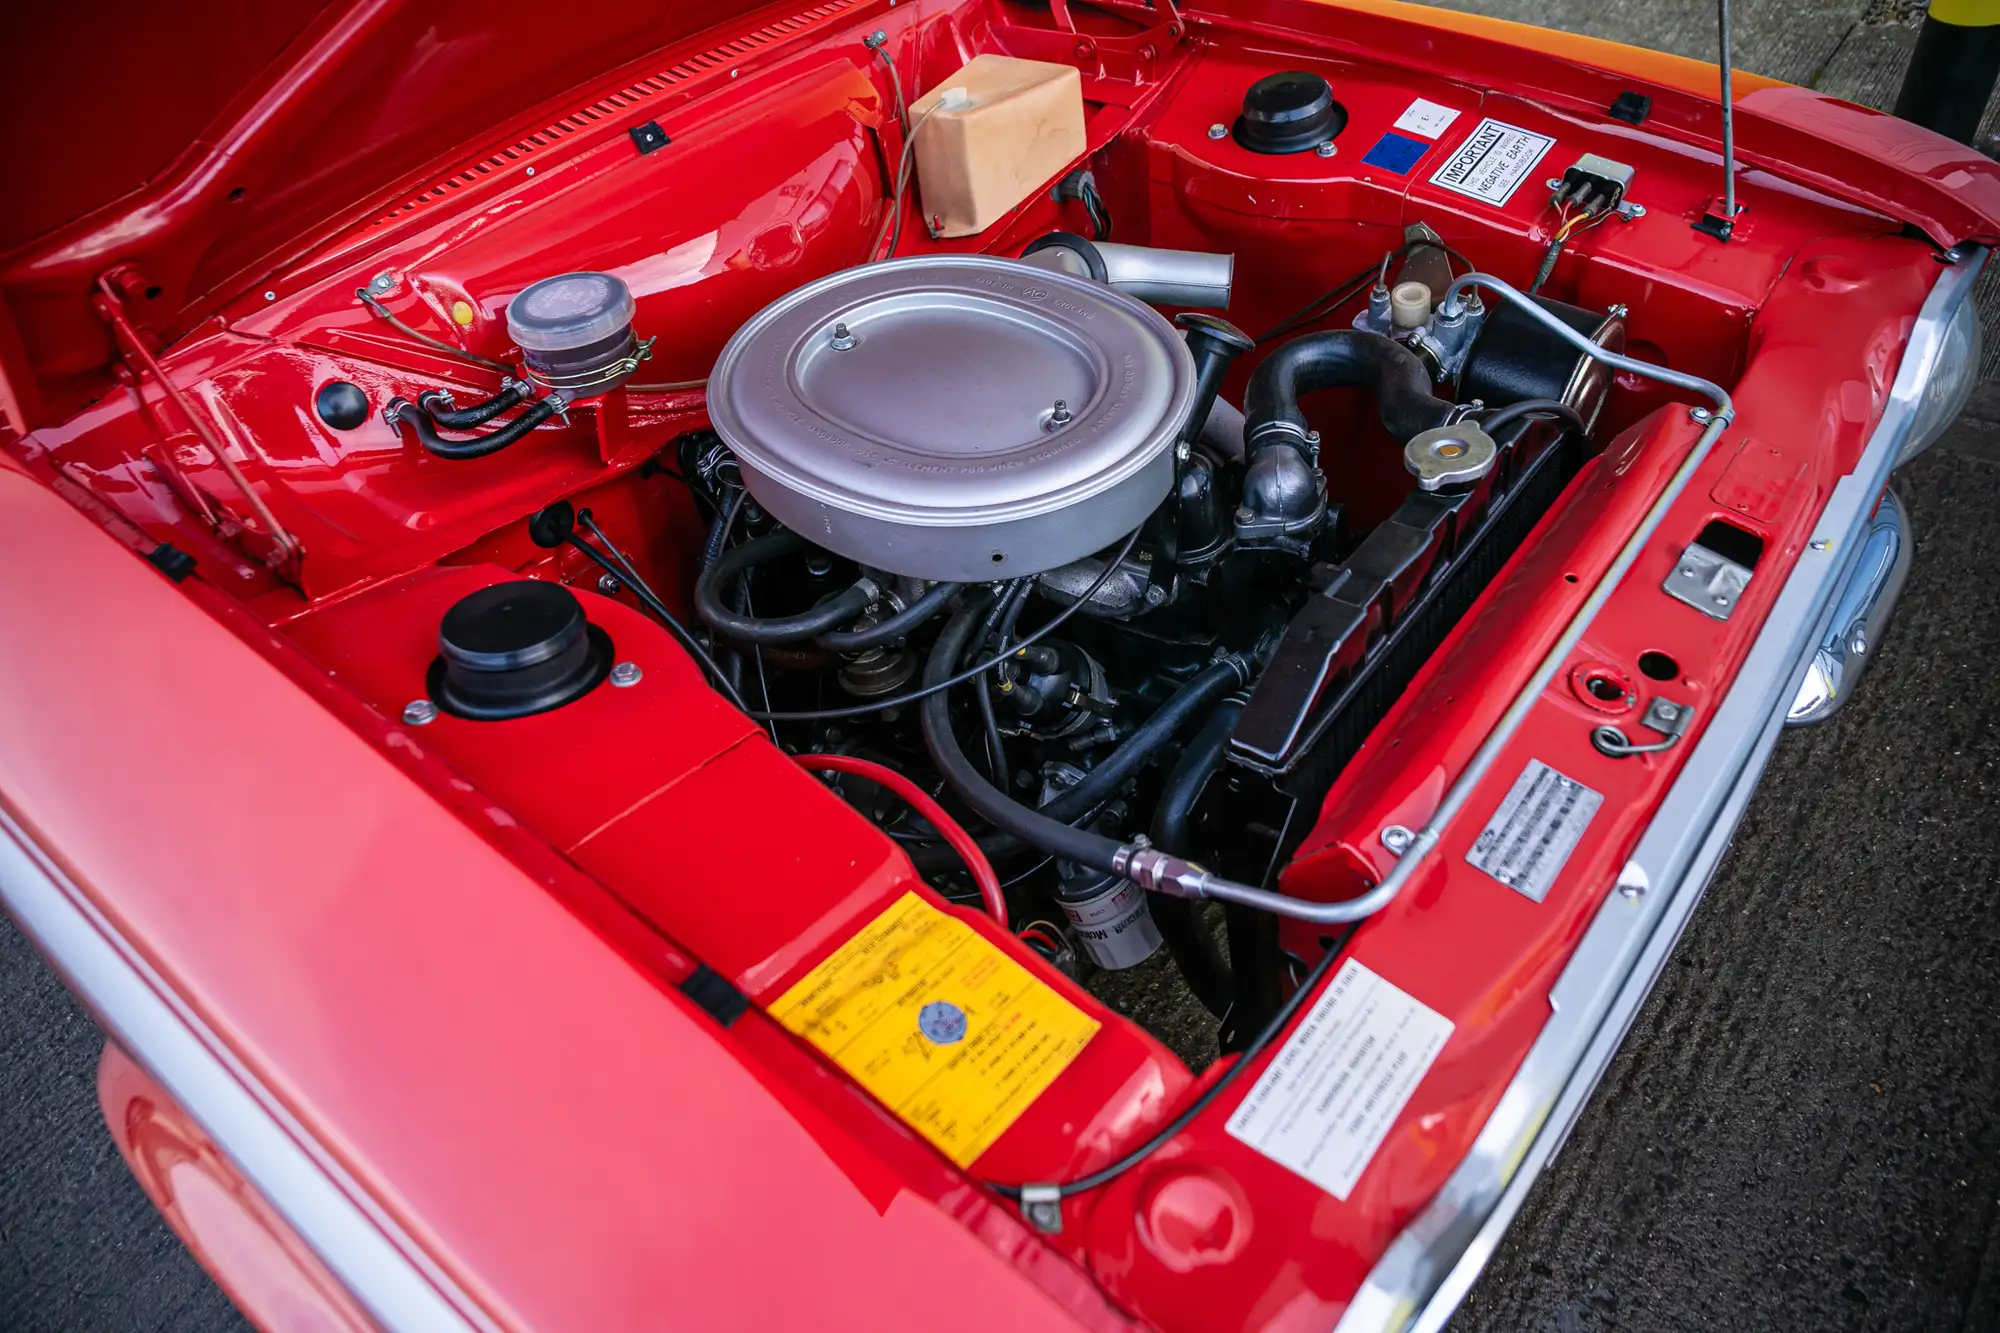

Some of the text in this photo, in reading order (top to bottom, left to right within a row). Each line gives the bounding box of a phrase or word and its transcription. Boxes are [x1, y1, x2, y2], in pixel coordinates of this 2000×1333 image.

[1442, 124, 1502, 183] IMPORTANT
[1465, 175, 1481, 188] THIS
[1475, 155, 1497, 176] VEHICLE
[1498, 132, 1517, 149] WIRED
[1475, 134, 1532, 194] NEGATIVE EARTH
[1496, 147, 1535, 189] SEE HANDBOOK
[1023, 287, 1048, 299] AC
[897, 457, 955, 475] ELEMENT
